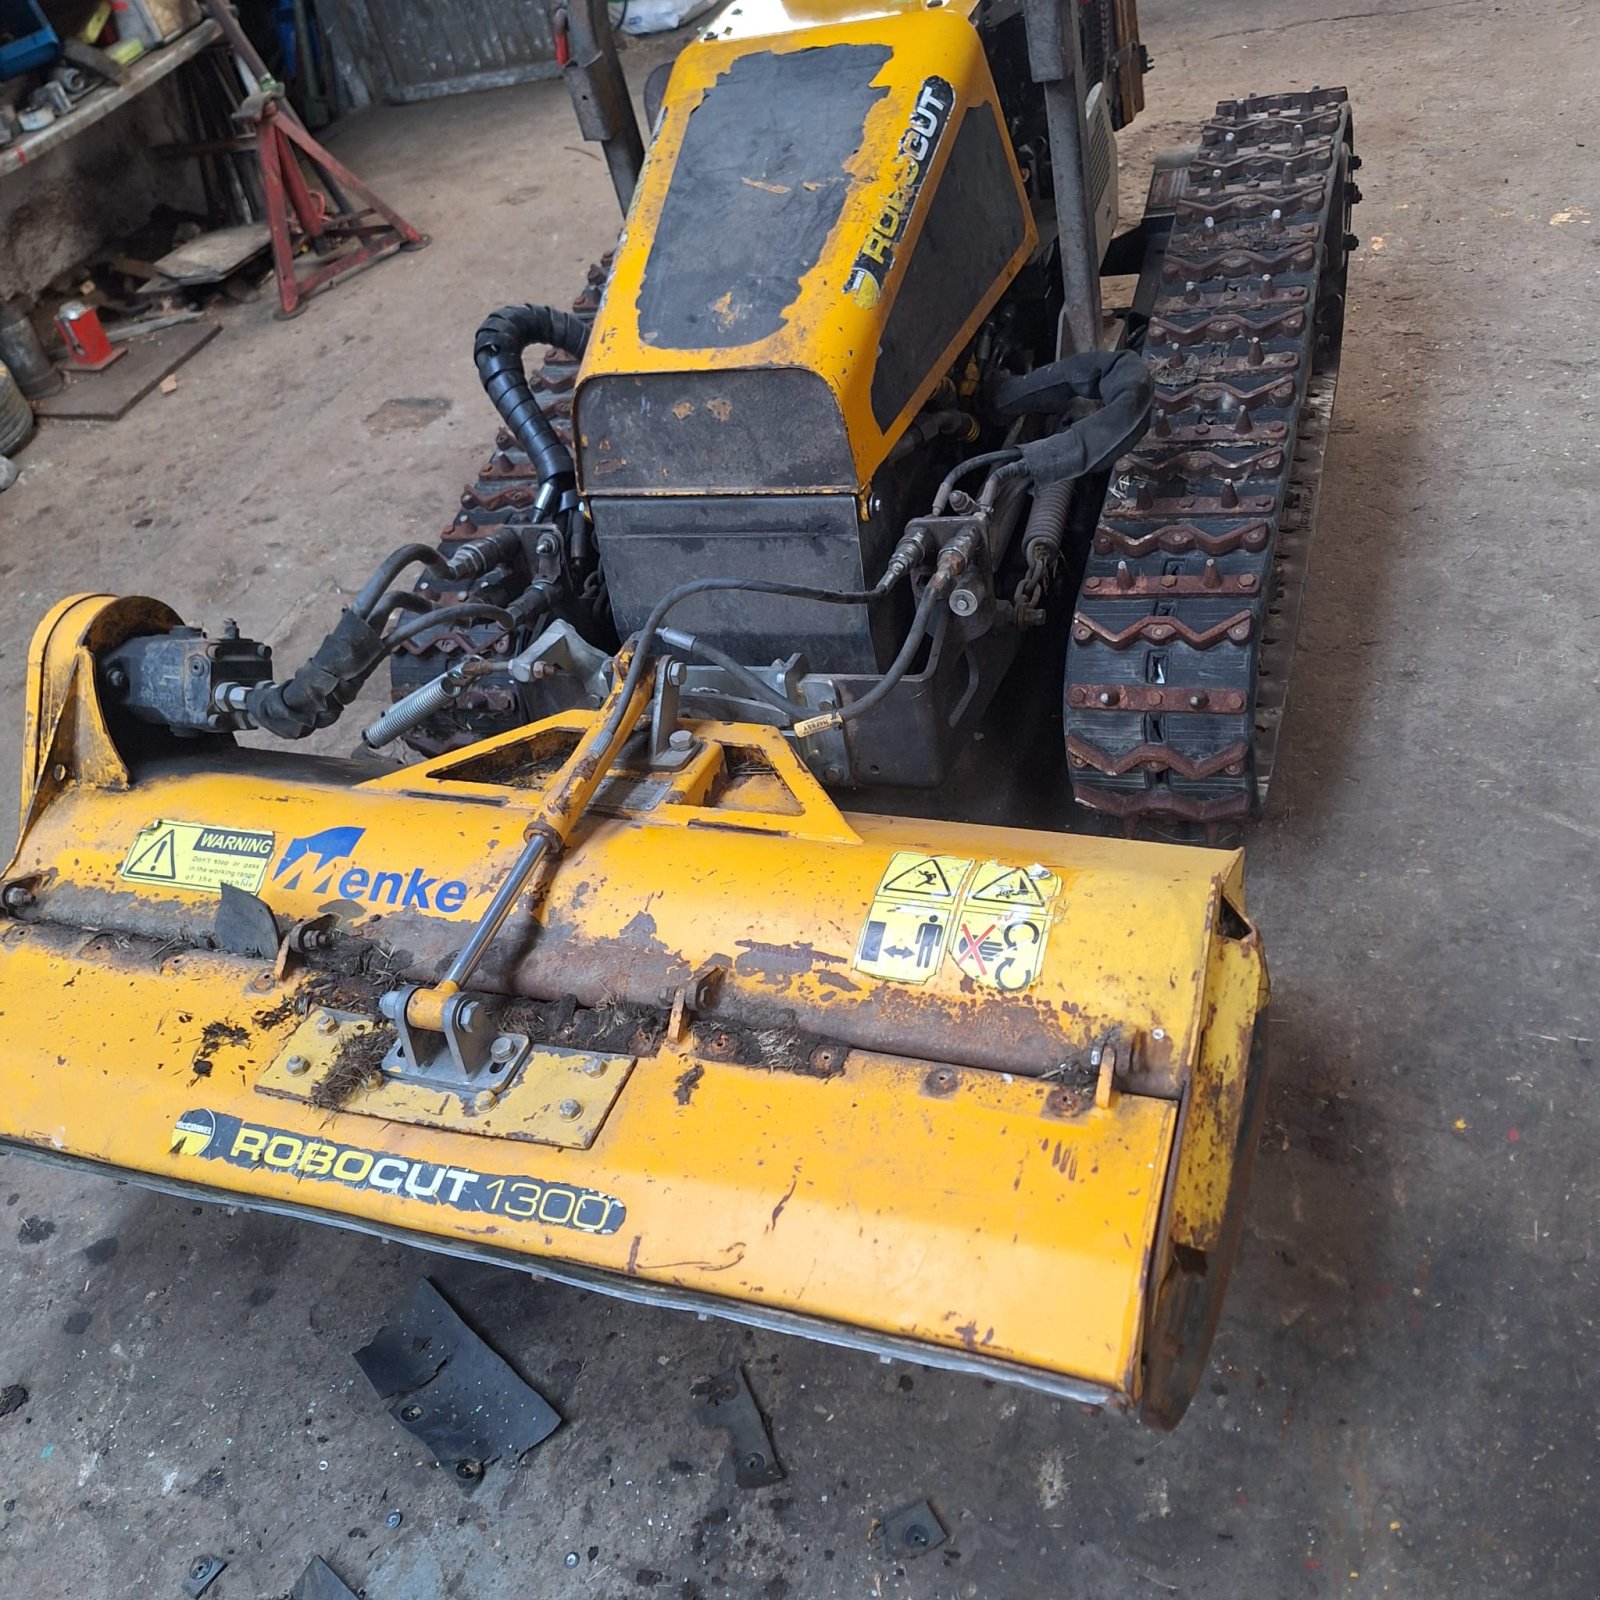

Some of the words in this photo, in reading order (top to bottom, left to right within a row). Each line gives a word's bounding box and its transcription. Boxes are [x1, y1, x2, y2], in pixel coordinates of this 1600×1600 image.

[200, 833, 273, 854] WARNING
[192, 855, 211, 863] Don't
[213, 858, 230, 866] stop
[273, 826, 468, 913] Menke
[208, 868, 236, 877] working
[236, 871, 256, 879] range
[229, 1127, 479, 1203] ROBOCUT
[485, 1178, 612, 1231] 1300
